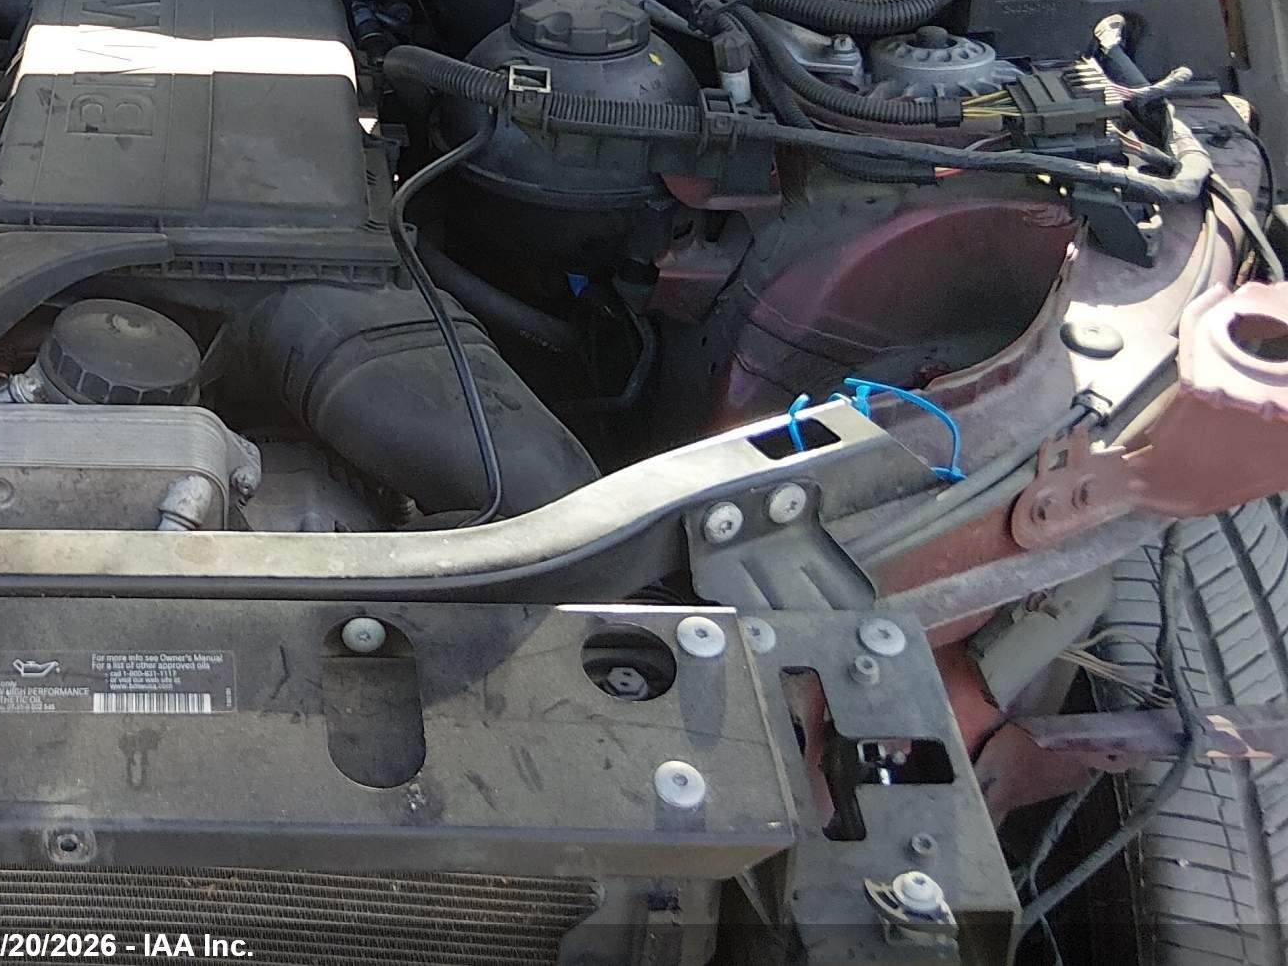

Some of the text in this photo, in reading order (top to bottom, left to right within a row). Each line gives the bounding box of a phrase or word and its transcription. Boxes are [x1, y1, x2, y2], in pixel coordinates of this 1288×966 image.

[92, 653, 224, 663] For more info see Owner's Manual
[92, 662, 105, 670] For
[158, 662, 196, 671] approved
[28, 687, 90, 696] PERFORMANCE
[29, 695, 42, 703] OIL
